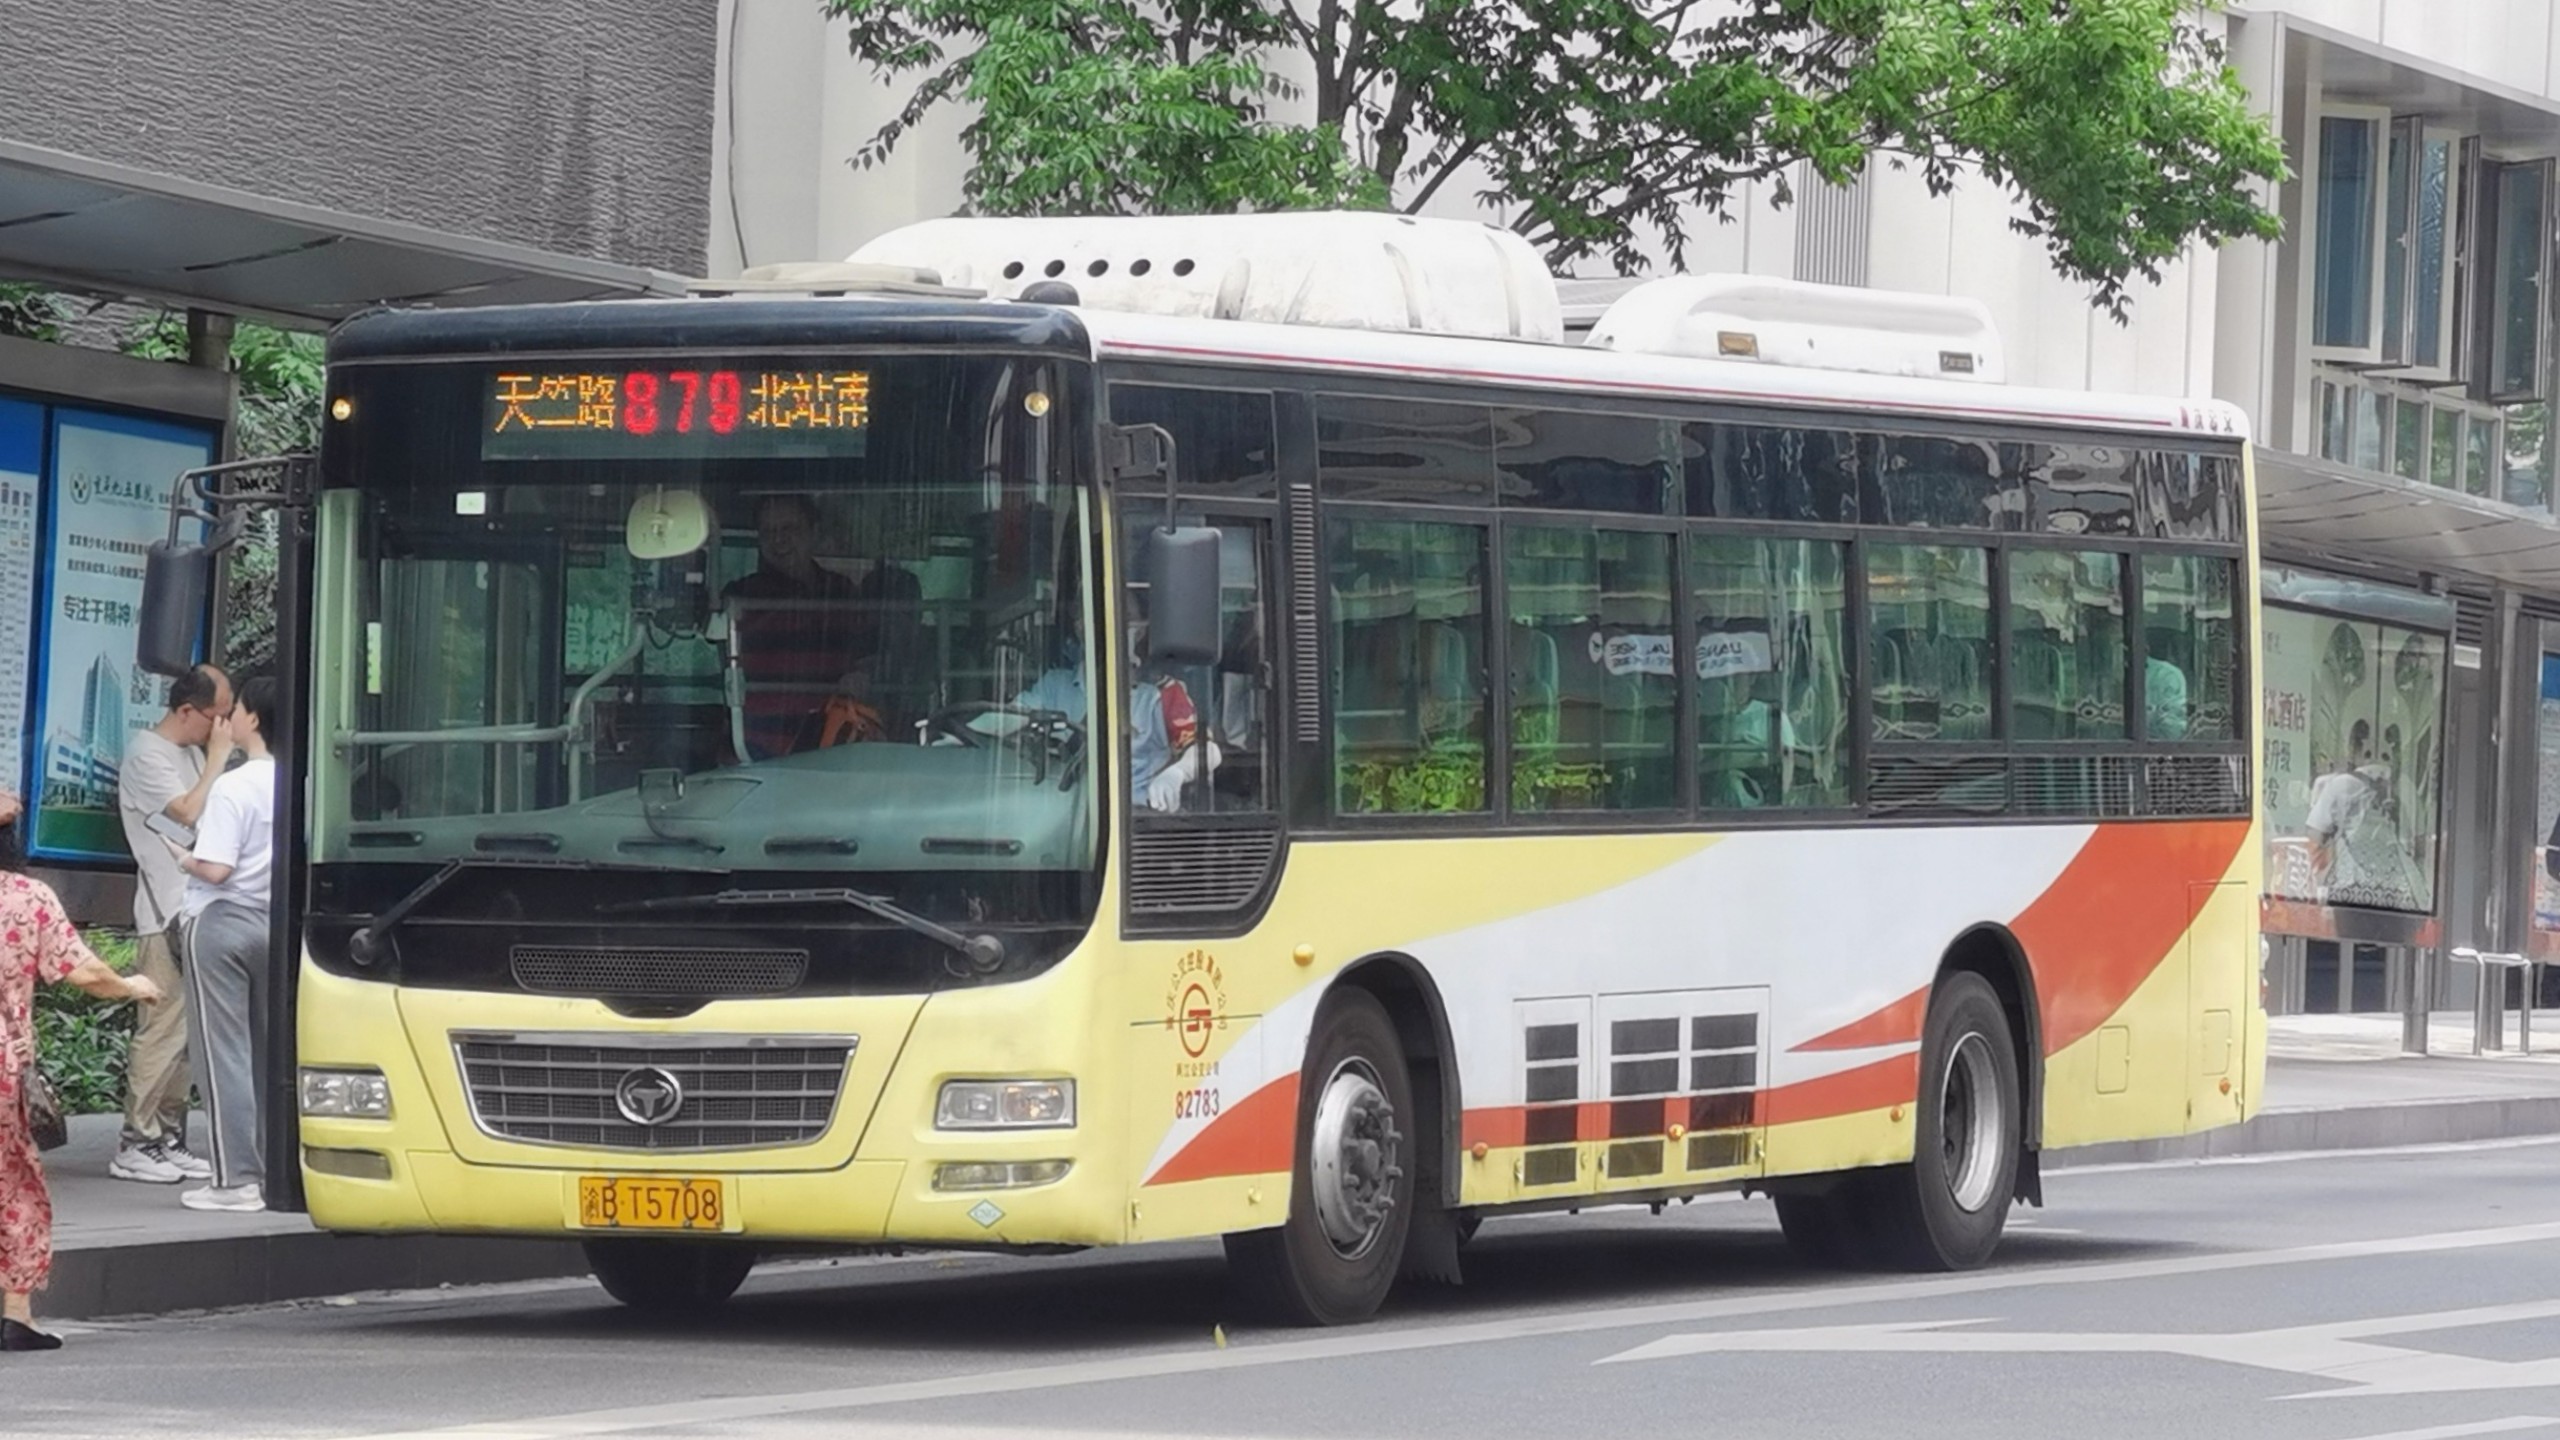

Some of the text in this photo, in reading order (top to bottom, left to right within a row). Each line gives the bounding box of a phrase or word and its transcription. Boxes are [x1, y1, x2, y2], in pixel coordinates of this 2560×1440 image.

[495, 371, 869, 434] 天竺路 879 北站南
[1175, 1088, 1220, 1120] 82783
